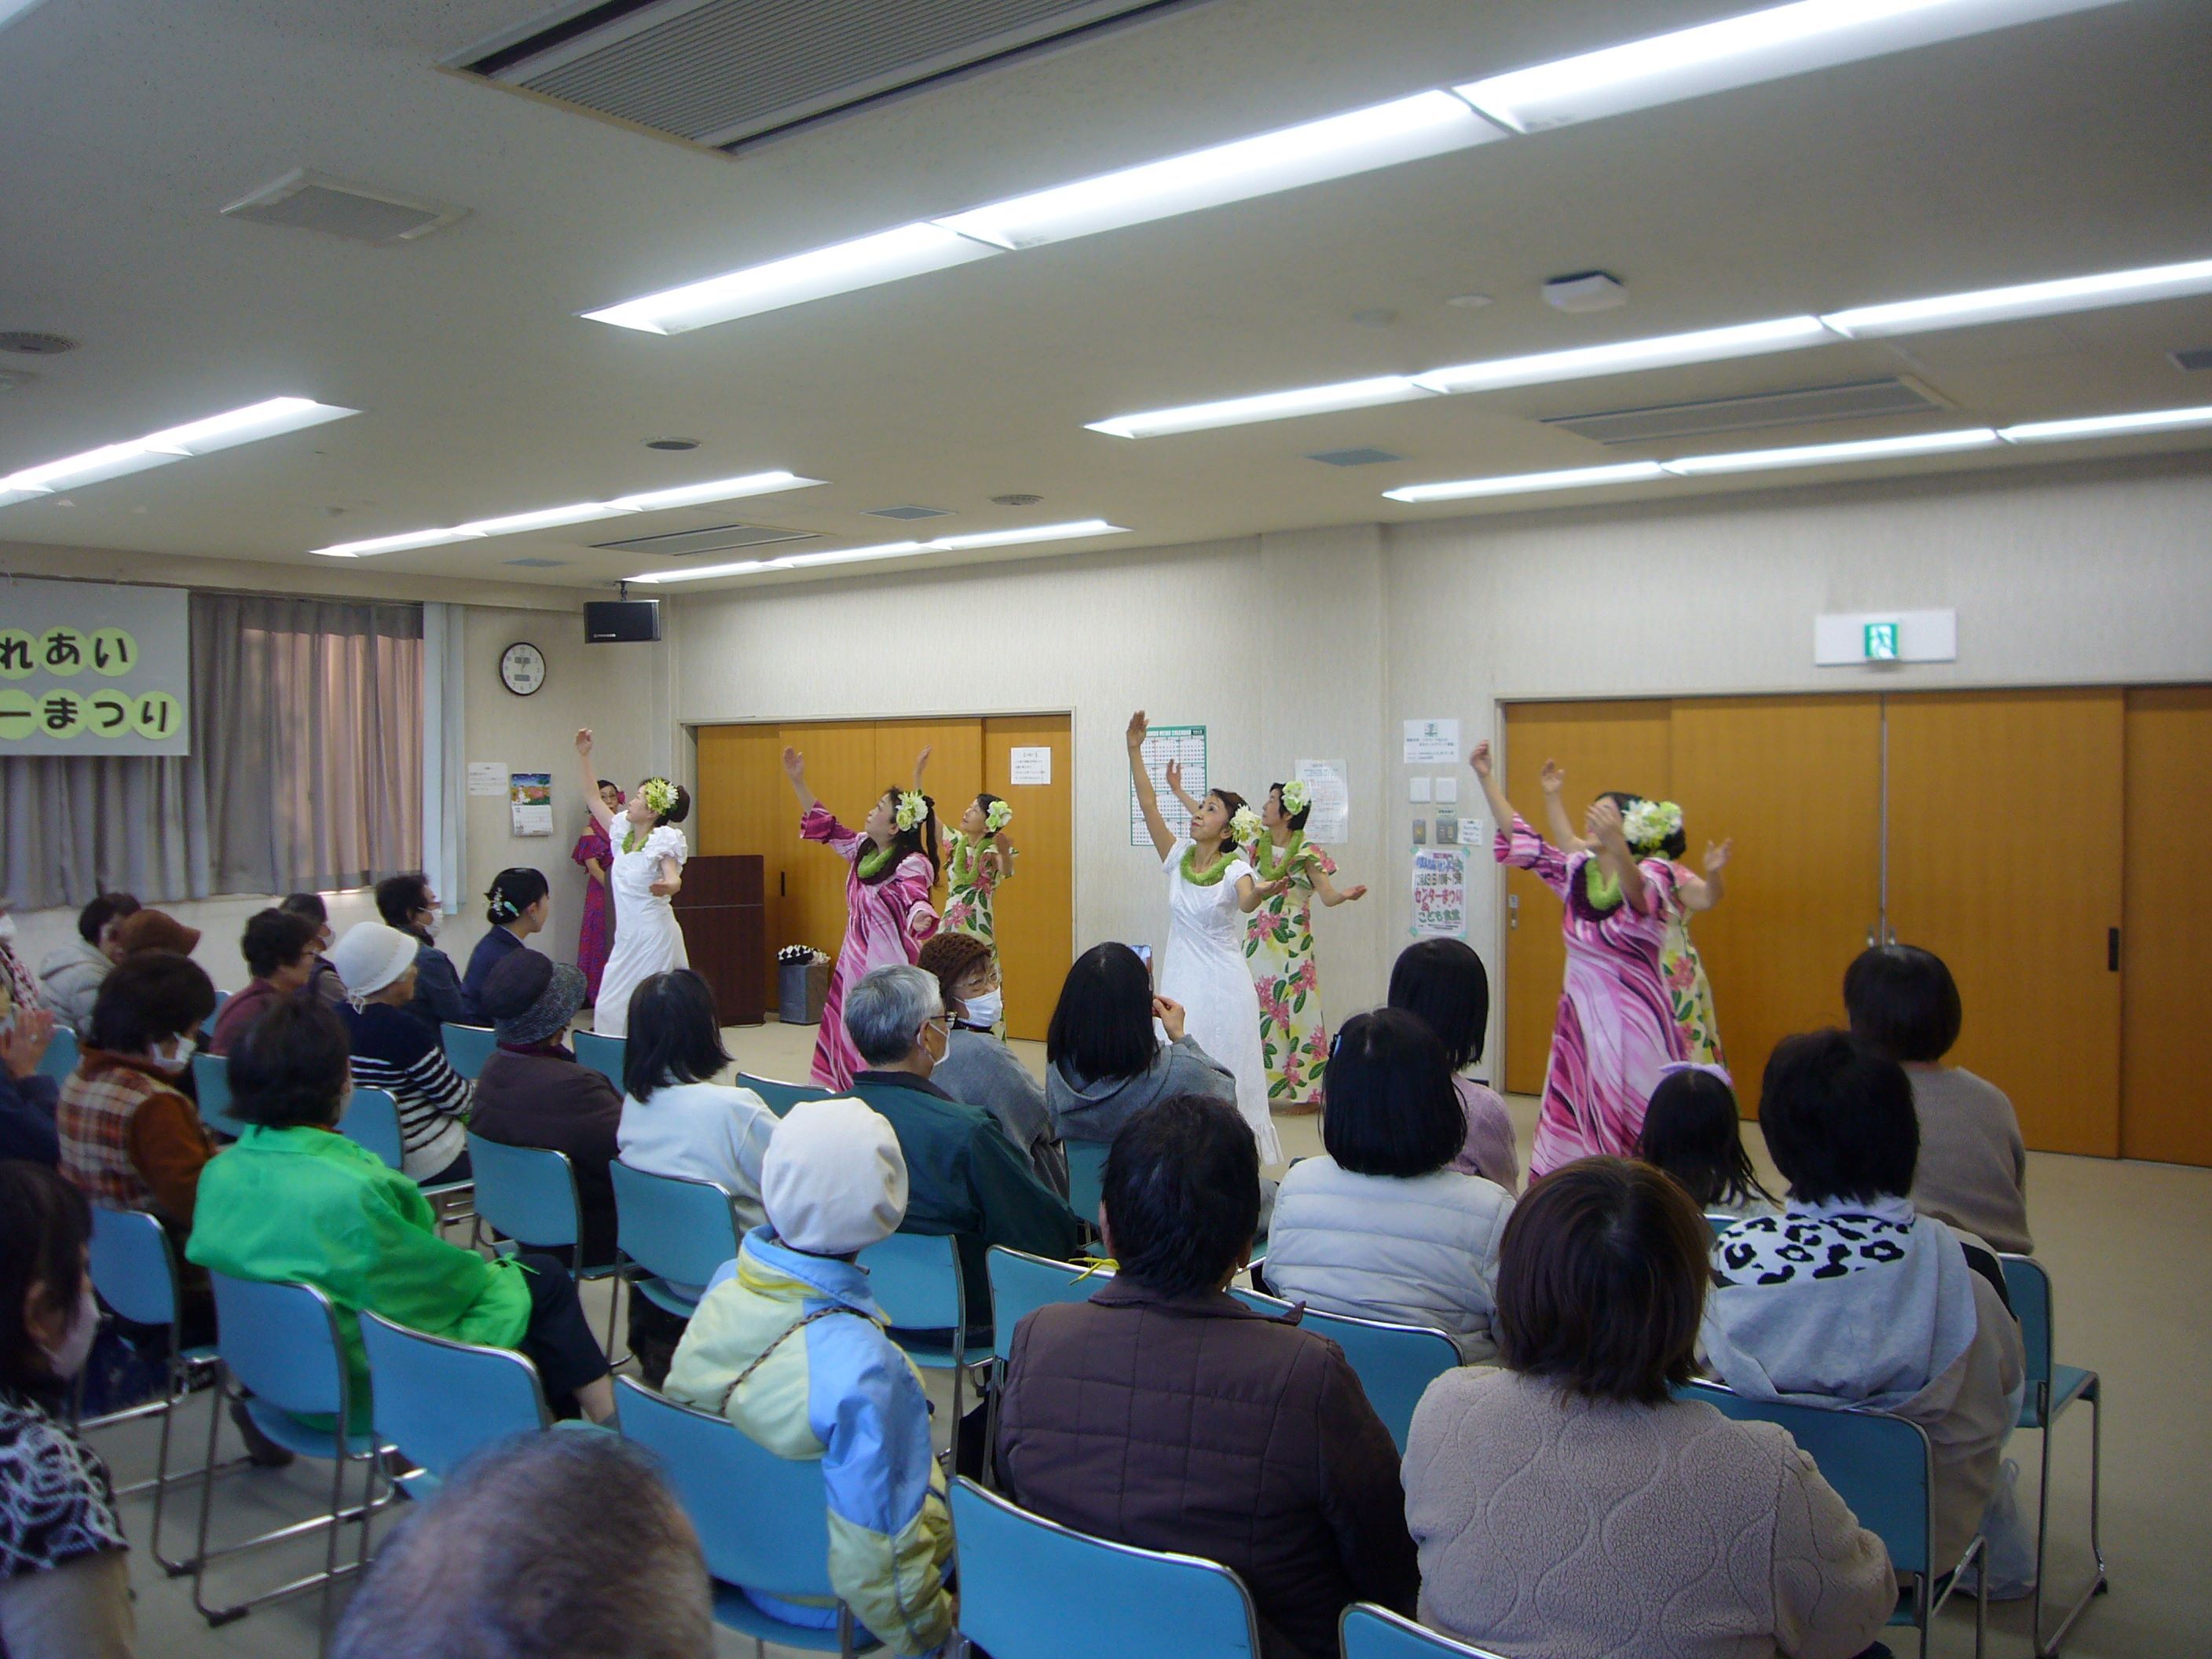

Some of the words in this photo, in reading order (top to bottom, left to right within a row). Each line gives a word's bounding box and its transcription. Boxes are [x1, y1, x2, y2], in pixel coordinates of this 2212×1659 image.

[0, 632, 128, 669] れあい
[0, 697, 167, 733] ーまつり
